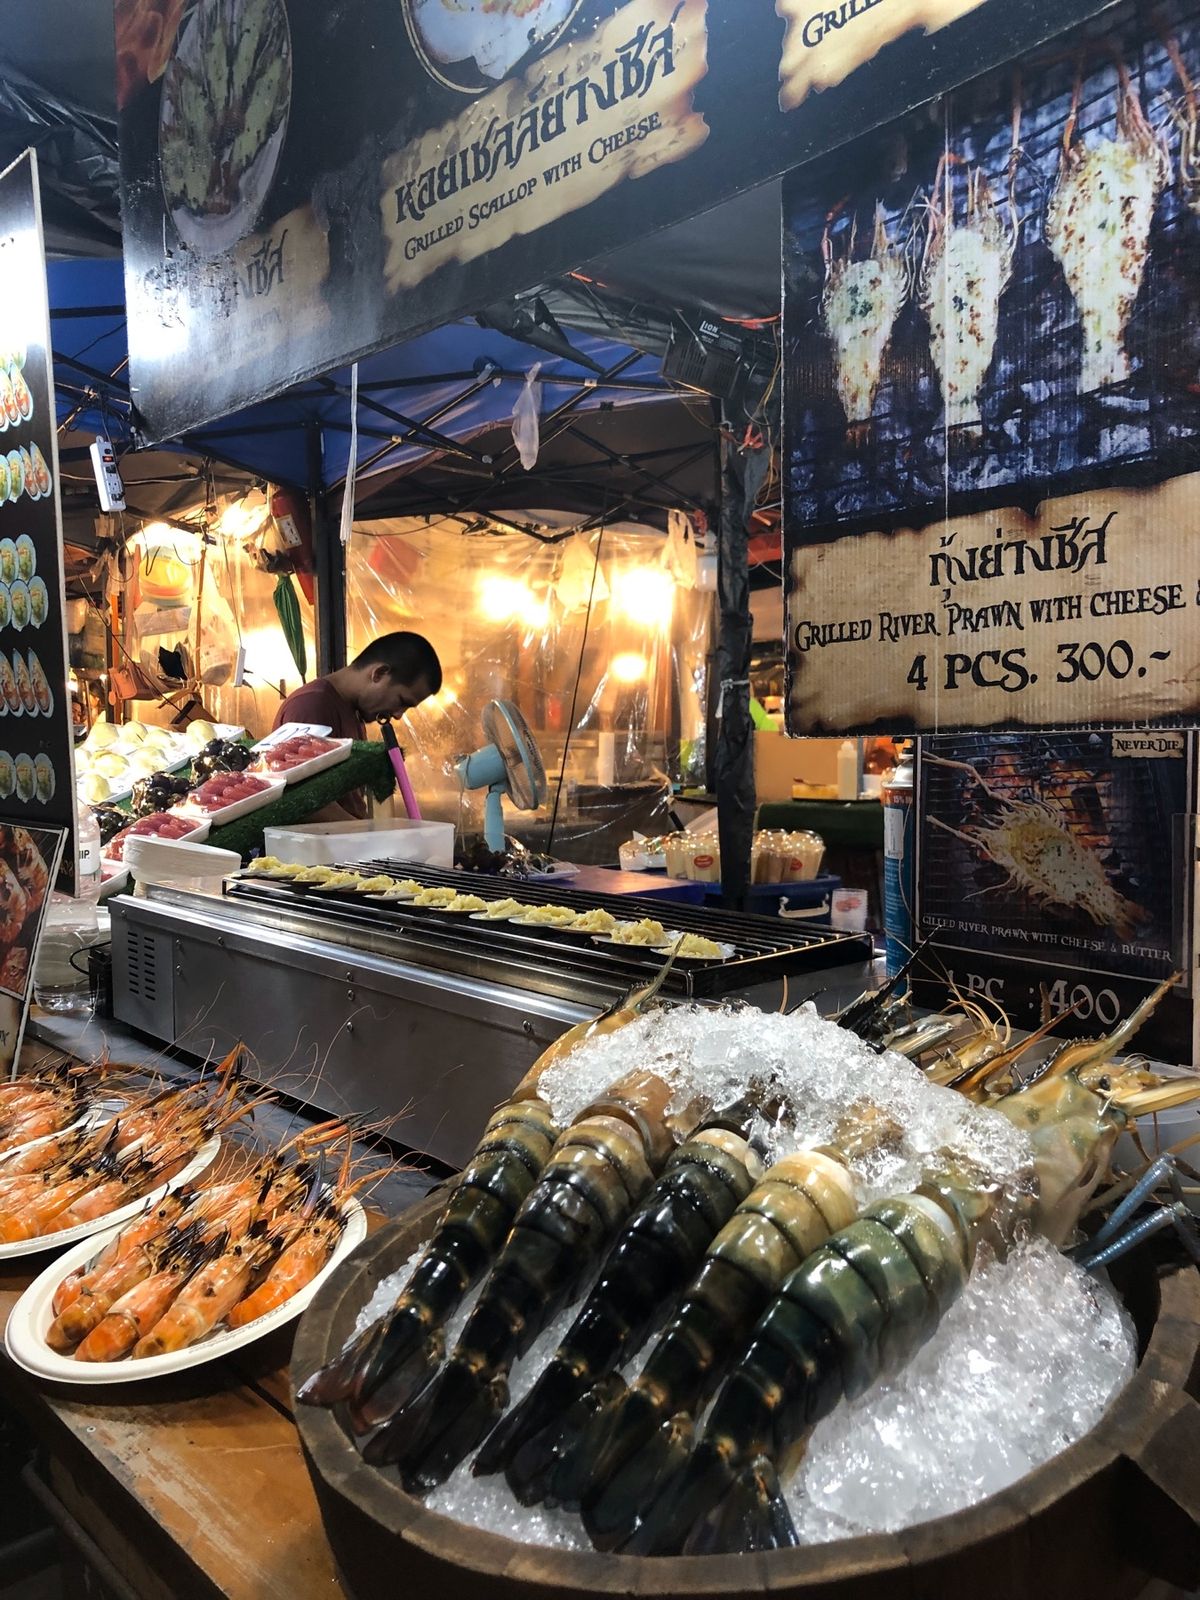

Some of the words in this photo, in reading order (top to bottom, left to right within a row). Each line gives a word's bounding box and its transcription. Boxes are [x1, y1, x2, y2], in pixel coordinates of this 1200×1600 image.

[404, 216, 464, 260] GRILLED
[468, 178, 538, 230] SCALLOP
[543, 157, 582, 187] WITH
[588, 112, 662, 164] CHEESE
[928, 511, 1118, 602] กุ้งย่างชีส
[795, 619, 872, 652] GRILLED
[878, 611, 942, 643] RIVER
[943, 601, 1025, 636] PRAWN
[1029, 594, 1083, 623] WITH
[1090, 584, 1187, 617] CHEESE
[907, 655, 928, 690] 4
[944, 647, 1038, 692] PCS.
[1115, 739, 1158, 752] NEVER
[1156, 738, 1181, 753] DIE
[958, 920, 989, 935] RIVER
[991, 926, 1029, 942] PRAWN
[1031, 931, 1058, 944] WITH
[1061, 936, 1106, 951] CHEESE
[1122, 944, 1174, 963] BUTTER
[966, 973, 1005, 1004] PC
[1048, 979, 1121, 1025] 400
